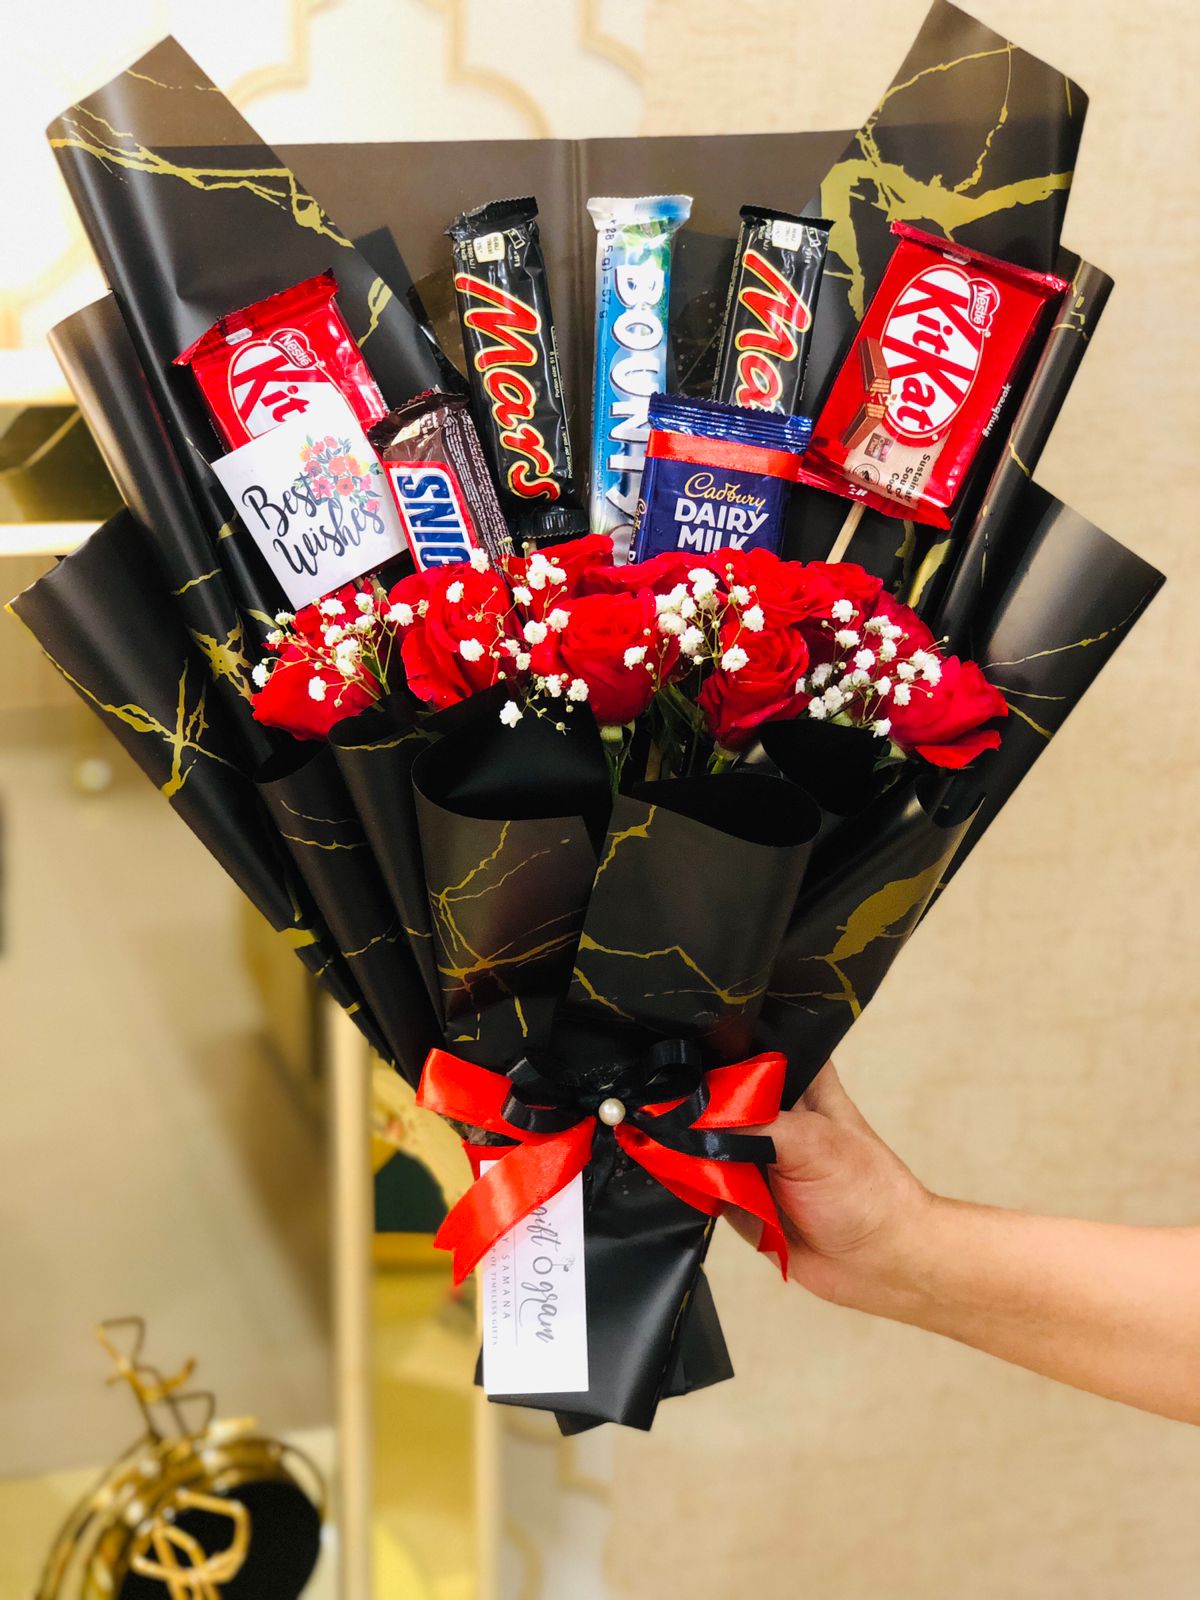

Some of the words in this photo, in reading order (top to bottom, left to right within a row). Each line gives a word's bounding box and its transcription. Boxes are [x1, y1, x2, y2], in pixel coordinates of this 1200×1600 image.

[602, 289, 612, 305] 57
[735, 249, 812, 408] Ma
[231, 355, 335, 432] Kit
[455, 272, 560, 500] Mars
[983, 383, 1012, 438] #mybreak
[242, 472, 321, 536] Best
[684, 472, 766, 514] Cadbury
[885, 472, 900, 495] Coc
[894, 466, 914, 499] Souc
[903, 453, 931, 504] Sustainab
[273, 498, 385, 576] Wishes
[397, 474, 471, 571] SNIC
[674, 497, 769, 534] DAIRY
[677, 525, 749, 553] MILK
[502, 1255, 511, 1320] SAMANA
[519, 1281, 558, 1344] gram
